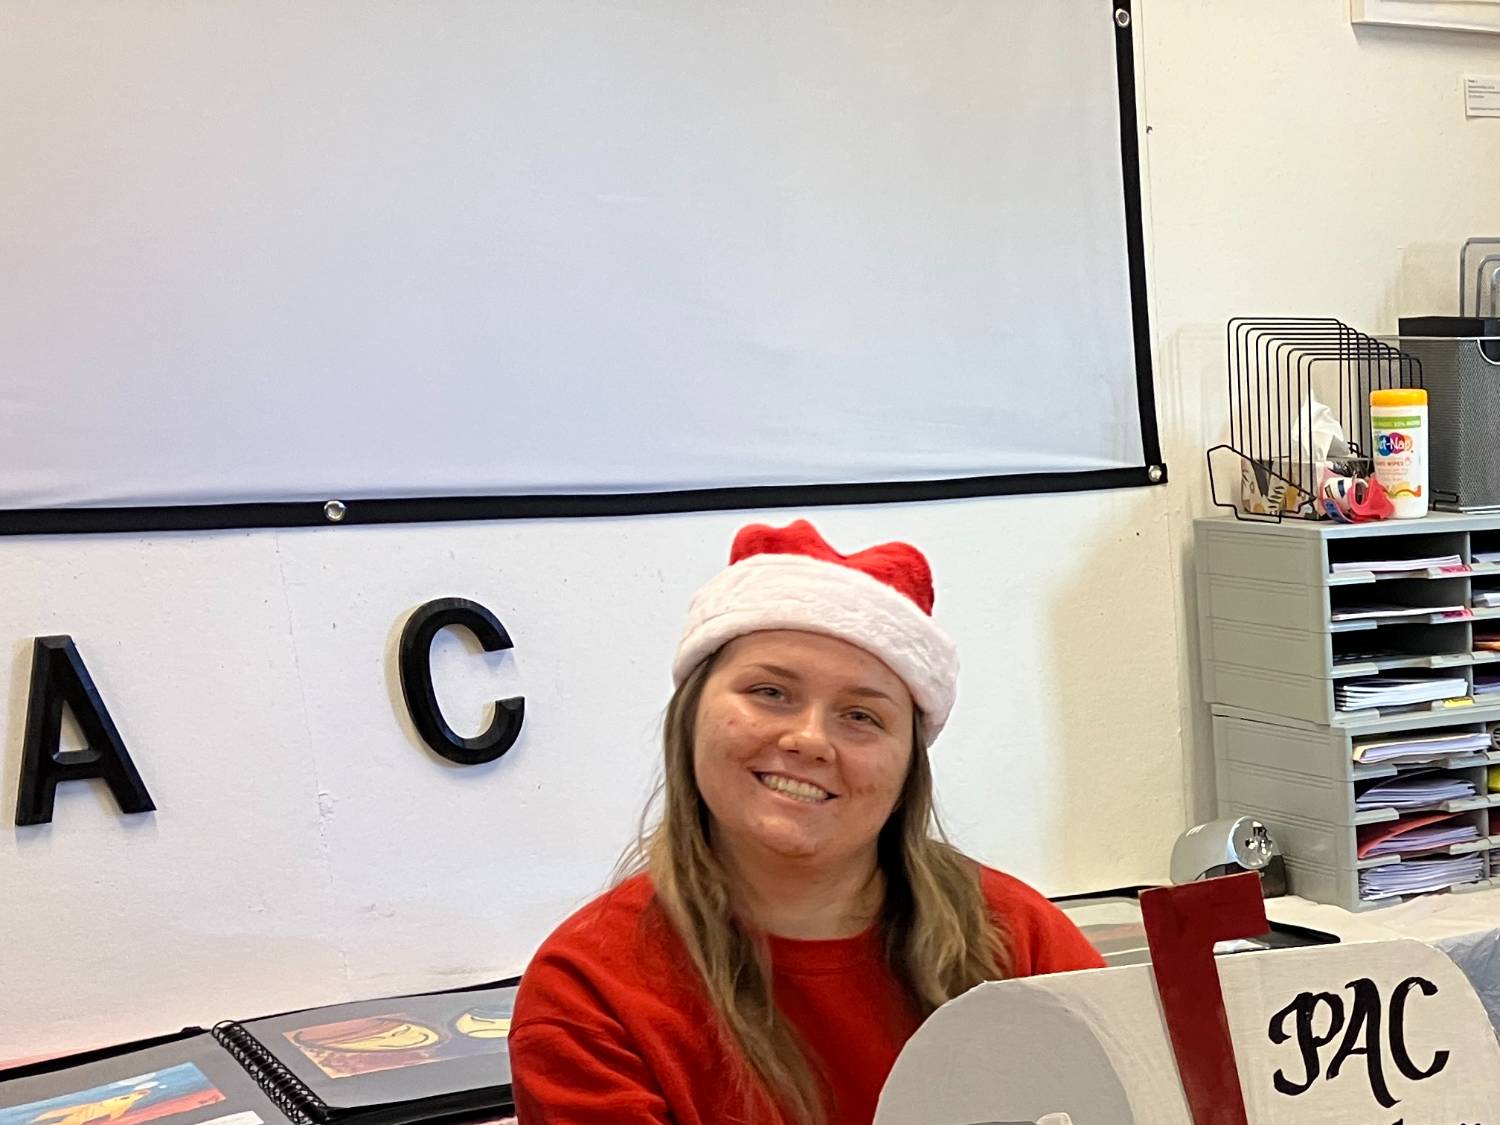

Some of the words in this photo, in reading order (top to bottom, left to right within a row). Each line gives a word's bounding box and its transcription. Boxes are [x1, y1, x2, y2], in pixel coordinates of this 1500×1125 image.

[15, 634, 157, 826] A
[399, 596, 526, 765] C
[1268, 976, 1450, 1109] PAC
